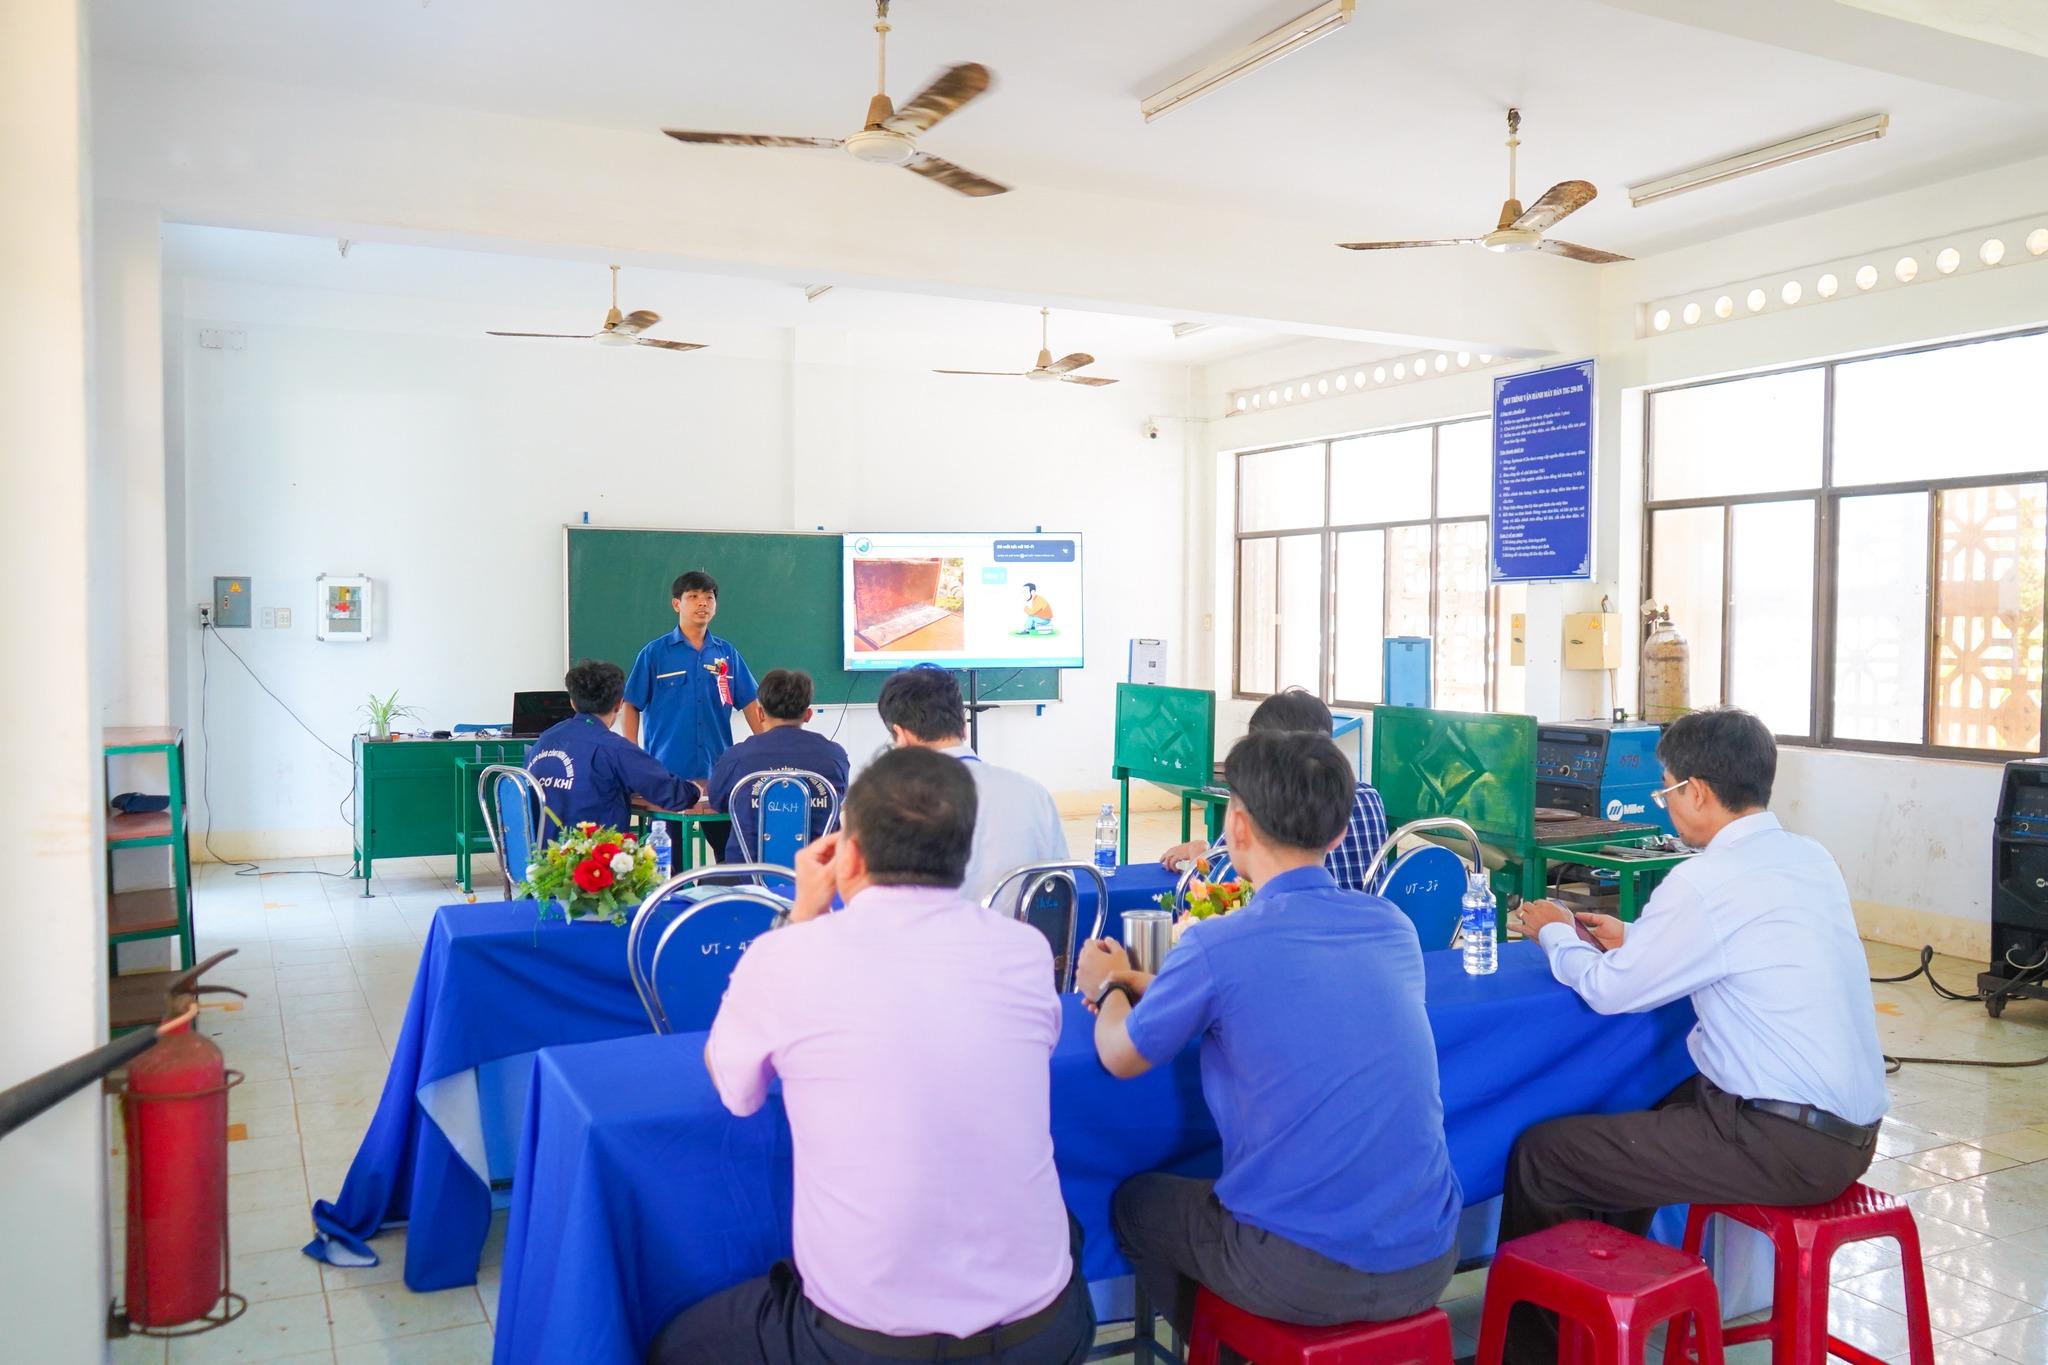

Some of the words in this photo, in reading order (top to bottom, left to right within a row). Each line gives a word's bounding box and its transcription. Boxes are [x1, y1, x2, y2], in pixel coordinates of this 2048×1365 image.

[539, 776, 554, 788] CƠ
[553, 778, 574, 790] KHÍ
[810, 796, 828, 808] KHÍ
[1623, 804, 1645, 815] Miller
